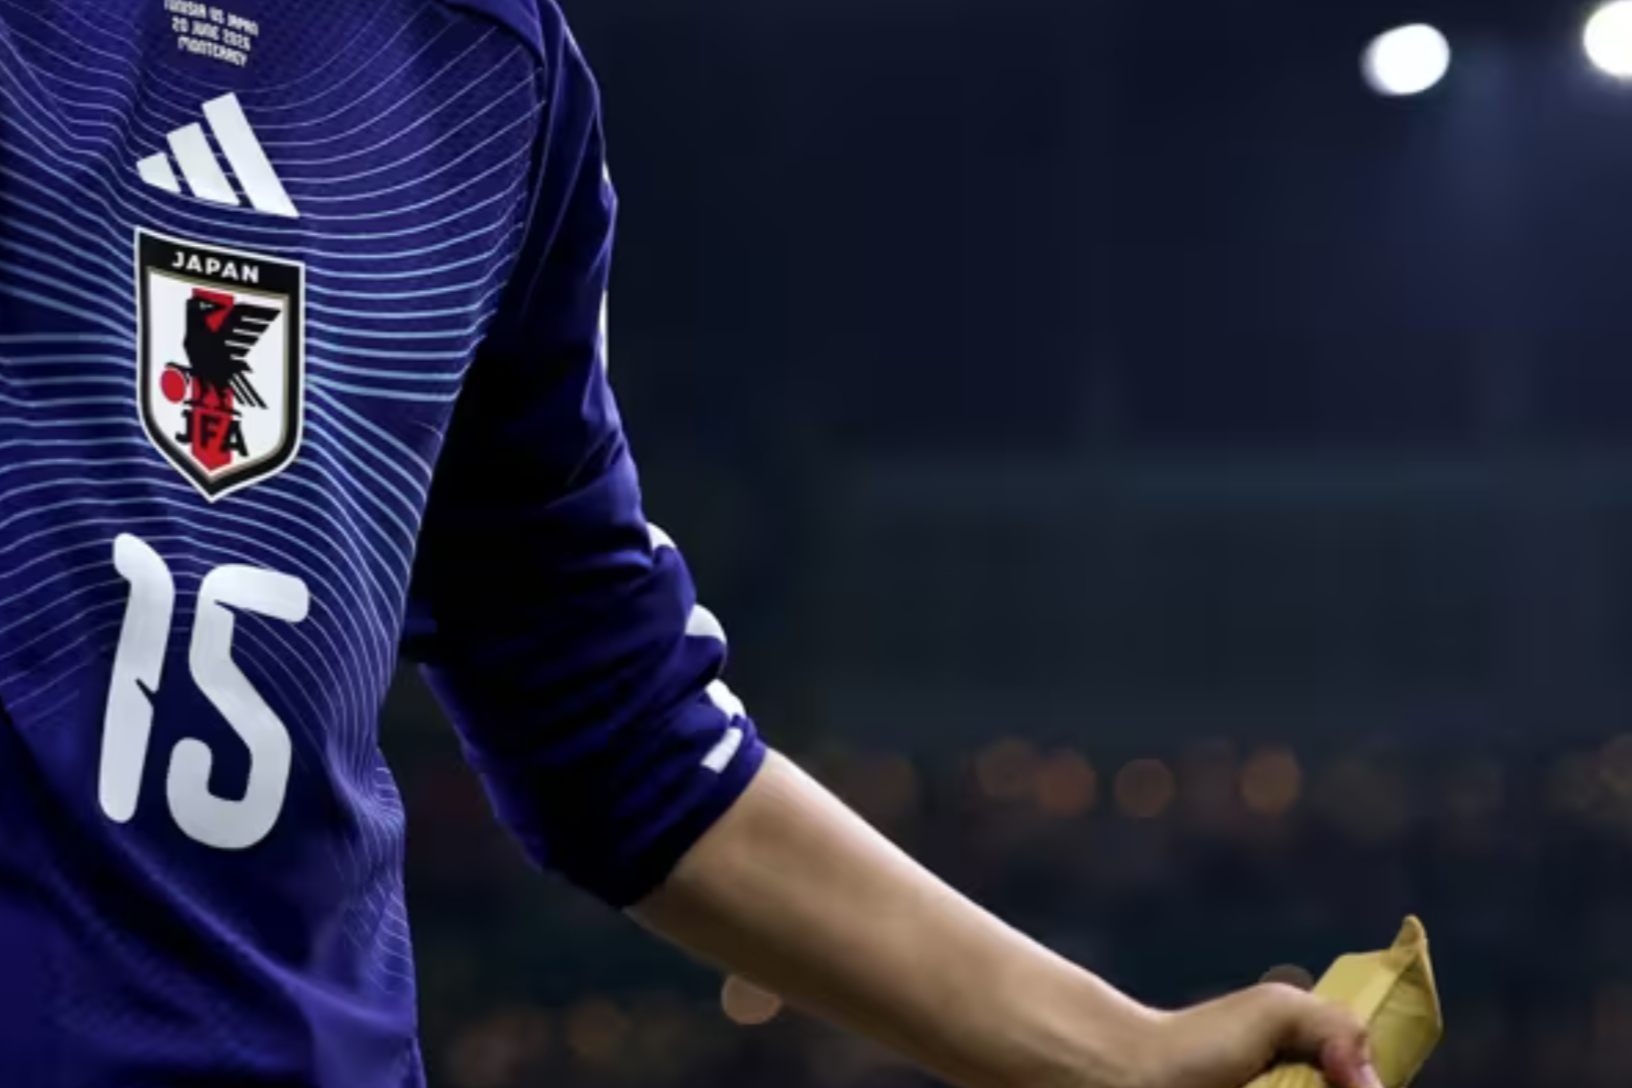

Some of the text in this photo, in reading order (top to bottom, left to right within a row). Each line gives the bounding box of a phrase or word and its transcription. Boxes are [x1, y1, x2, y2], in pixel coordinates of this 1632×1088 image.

[171, 251, 260, 283] JAPAN
[175, 410, 250, 457] JFA
[98, 532, 310, 851] 15
